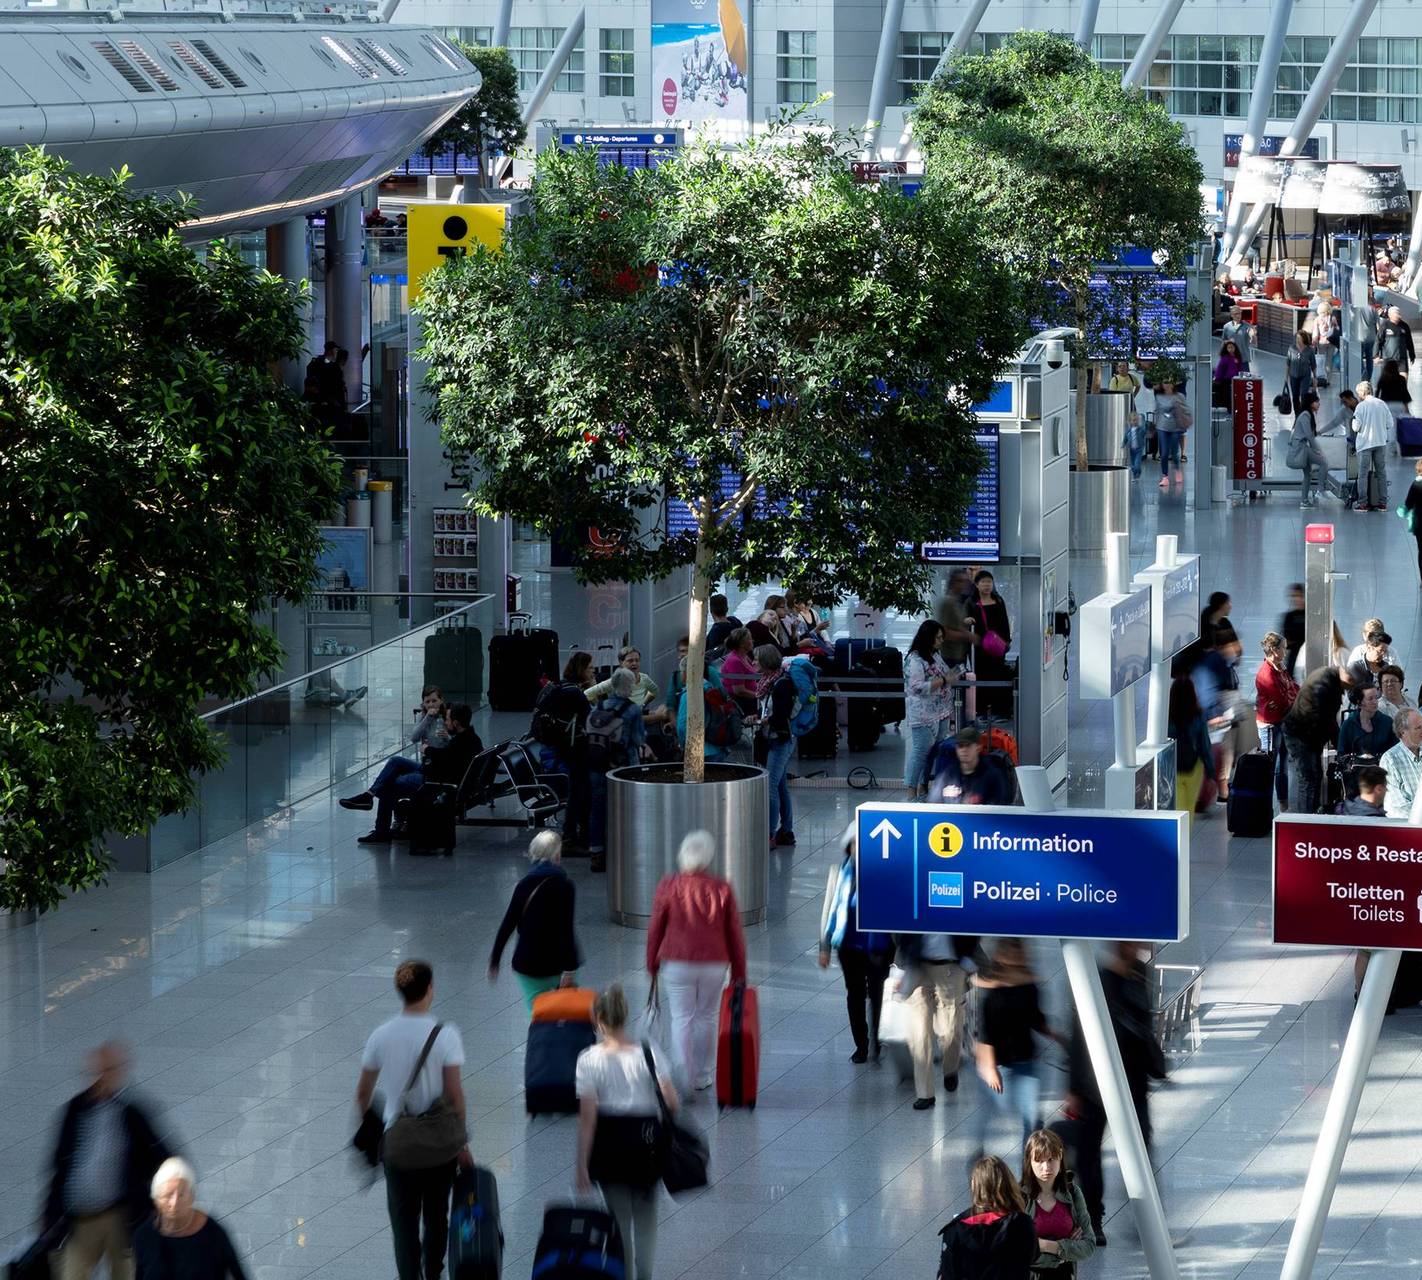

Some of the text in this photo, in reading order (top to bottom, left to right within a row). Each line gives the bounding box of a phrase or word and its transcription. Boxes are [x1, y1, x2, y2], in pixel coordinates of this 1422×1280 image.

[1246, 449, 1257, 479] BAG
[973, 831, 1093, 853] Information
[1294, 842, 1352, 866] Shops
[1358, 845, 1371, 861] &
[931, 883, 961, 897] Polizei
[973, 881, 1040, 901] Polizei
[1057, 884, 1117, 903] Police
[1327, 882, 1404, 901] Toiletten
[1349, 904, 1404, 923] Toilets
